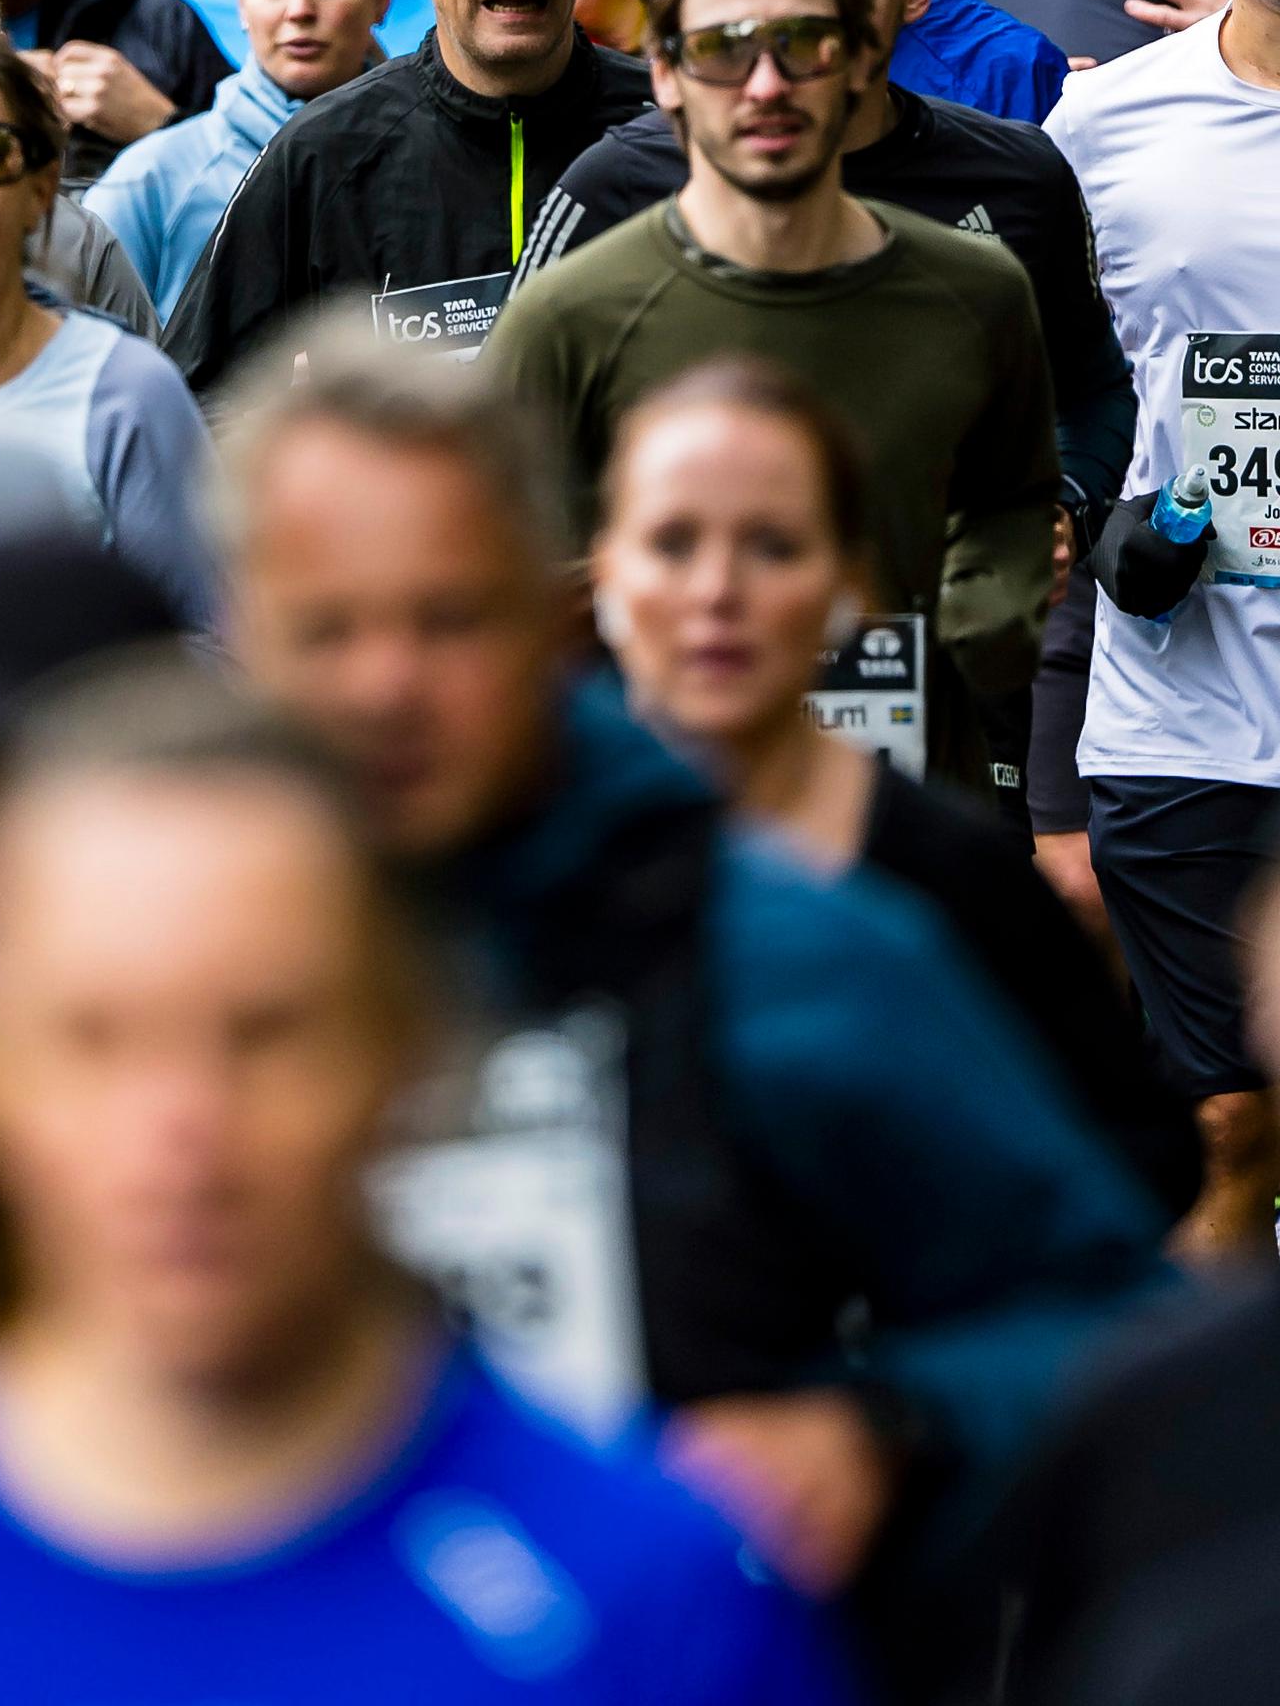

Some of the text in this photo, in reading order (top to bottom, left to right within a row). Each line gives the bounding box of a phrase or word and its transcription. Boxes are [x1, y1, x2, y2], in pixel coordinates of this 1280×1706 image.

[443, 298, 477, 313] TATA
[445, 306, 498, 325] CONSULTA
[388, 311, 442, 343] tcs
[1248, 351, 1280, 362] TATA
[1193, 350, 1244, 385] tcs
